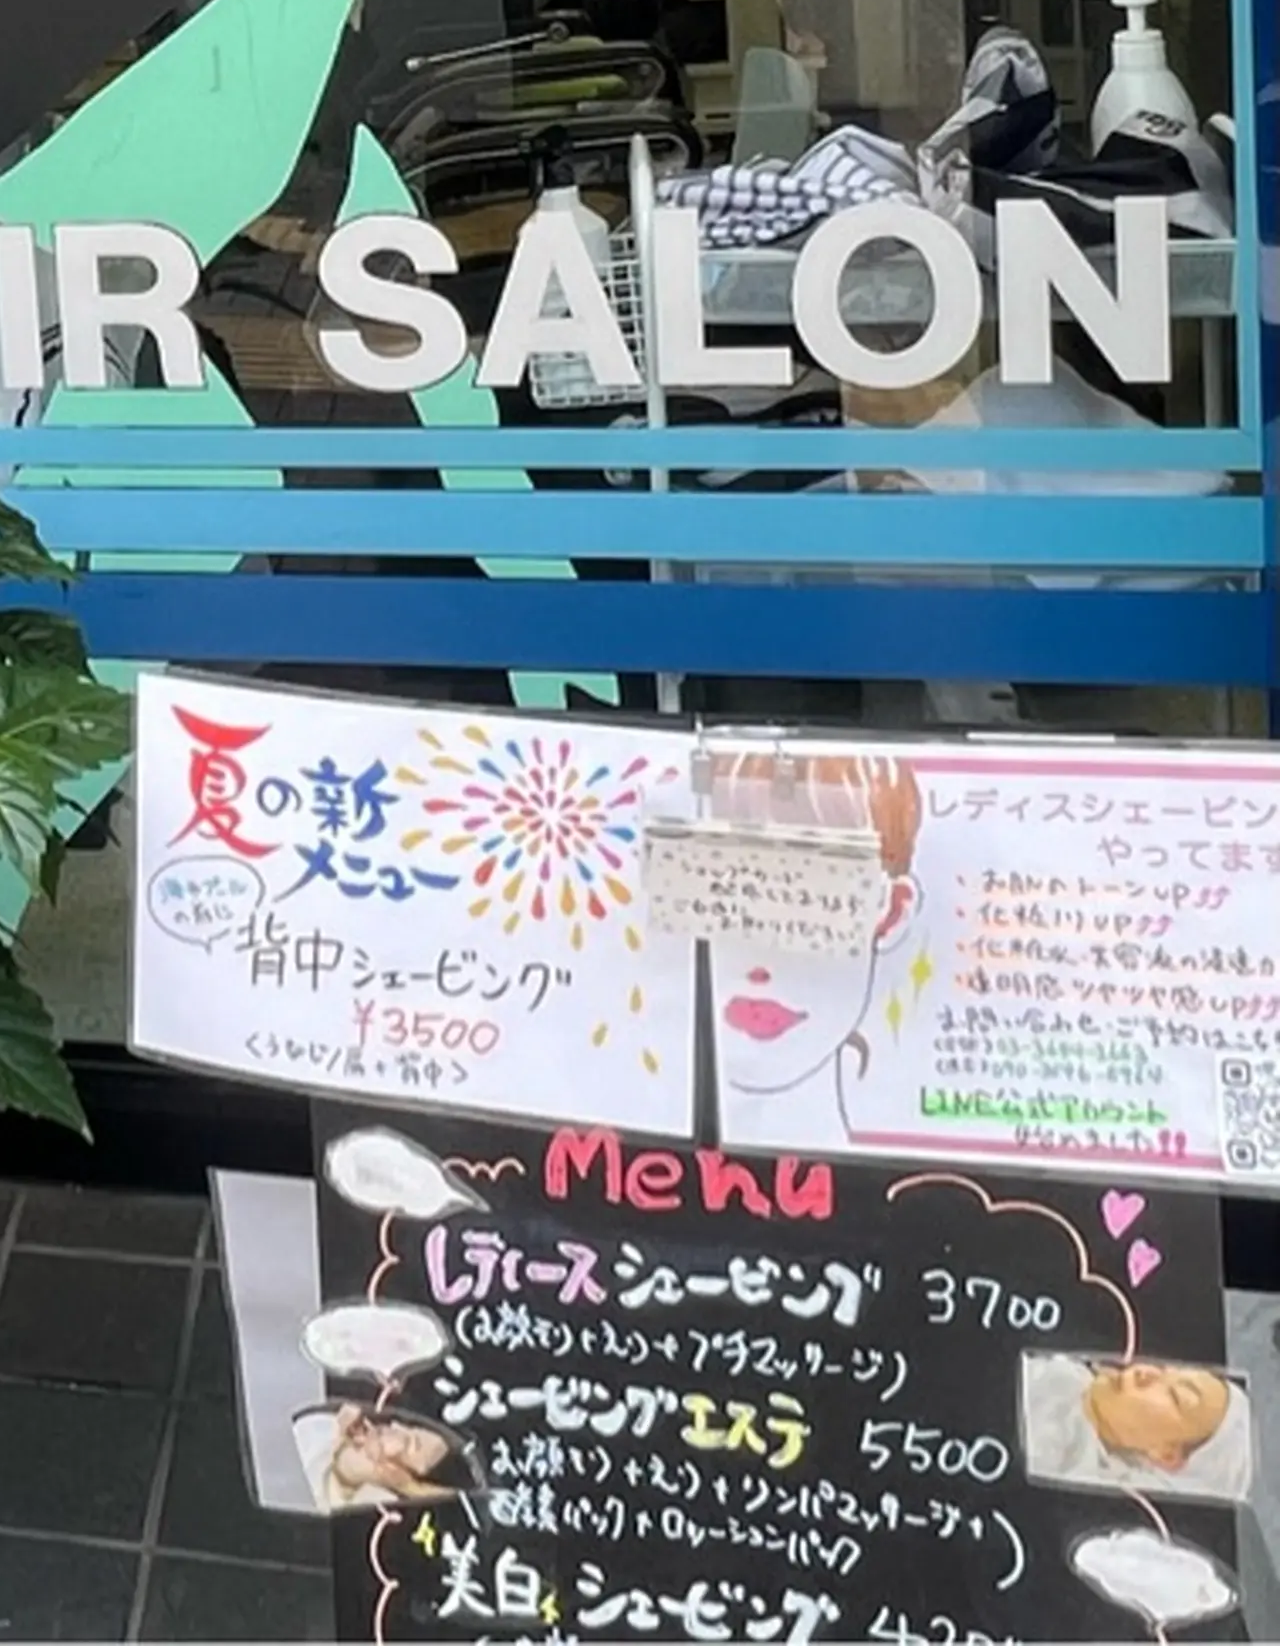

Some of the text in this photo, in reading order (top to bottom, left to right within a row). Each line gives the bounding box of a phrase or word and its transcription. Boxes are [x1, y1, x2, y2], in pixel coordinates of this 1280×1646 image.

[315, 197, 1173, 394] SALON
[165, 703, 401, 862] 夏の新
[271, 837, 461, 904] メニュー
[351, 997, 502, 1057] ¥3500
[542, 1124, 835, 1221] Menu
[922, 1267, 1063, 1333] 3700
[858, 1417, 1012, 1484] 5500
[435, 1529, 542, 1621] 美白
